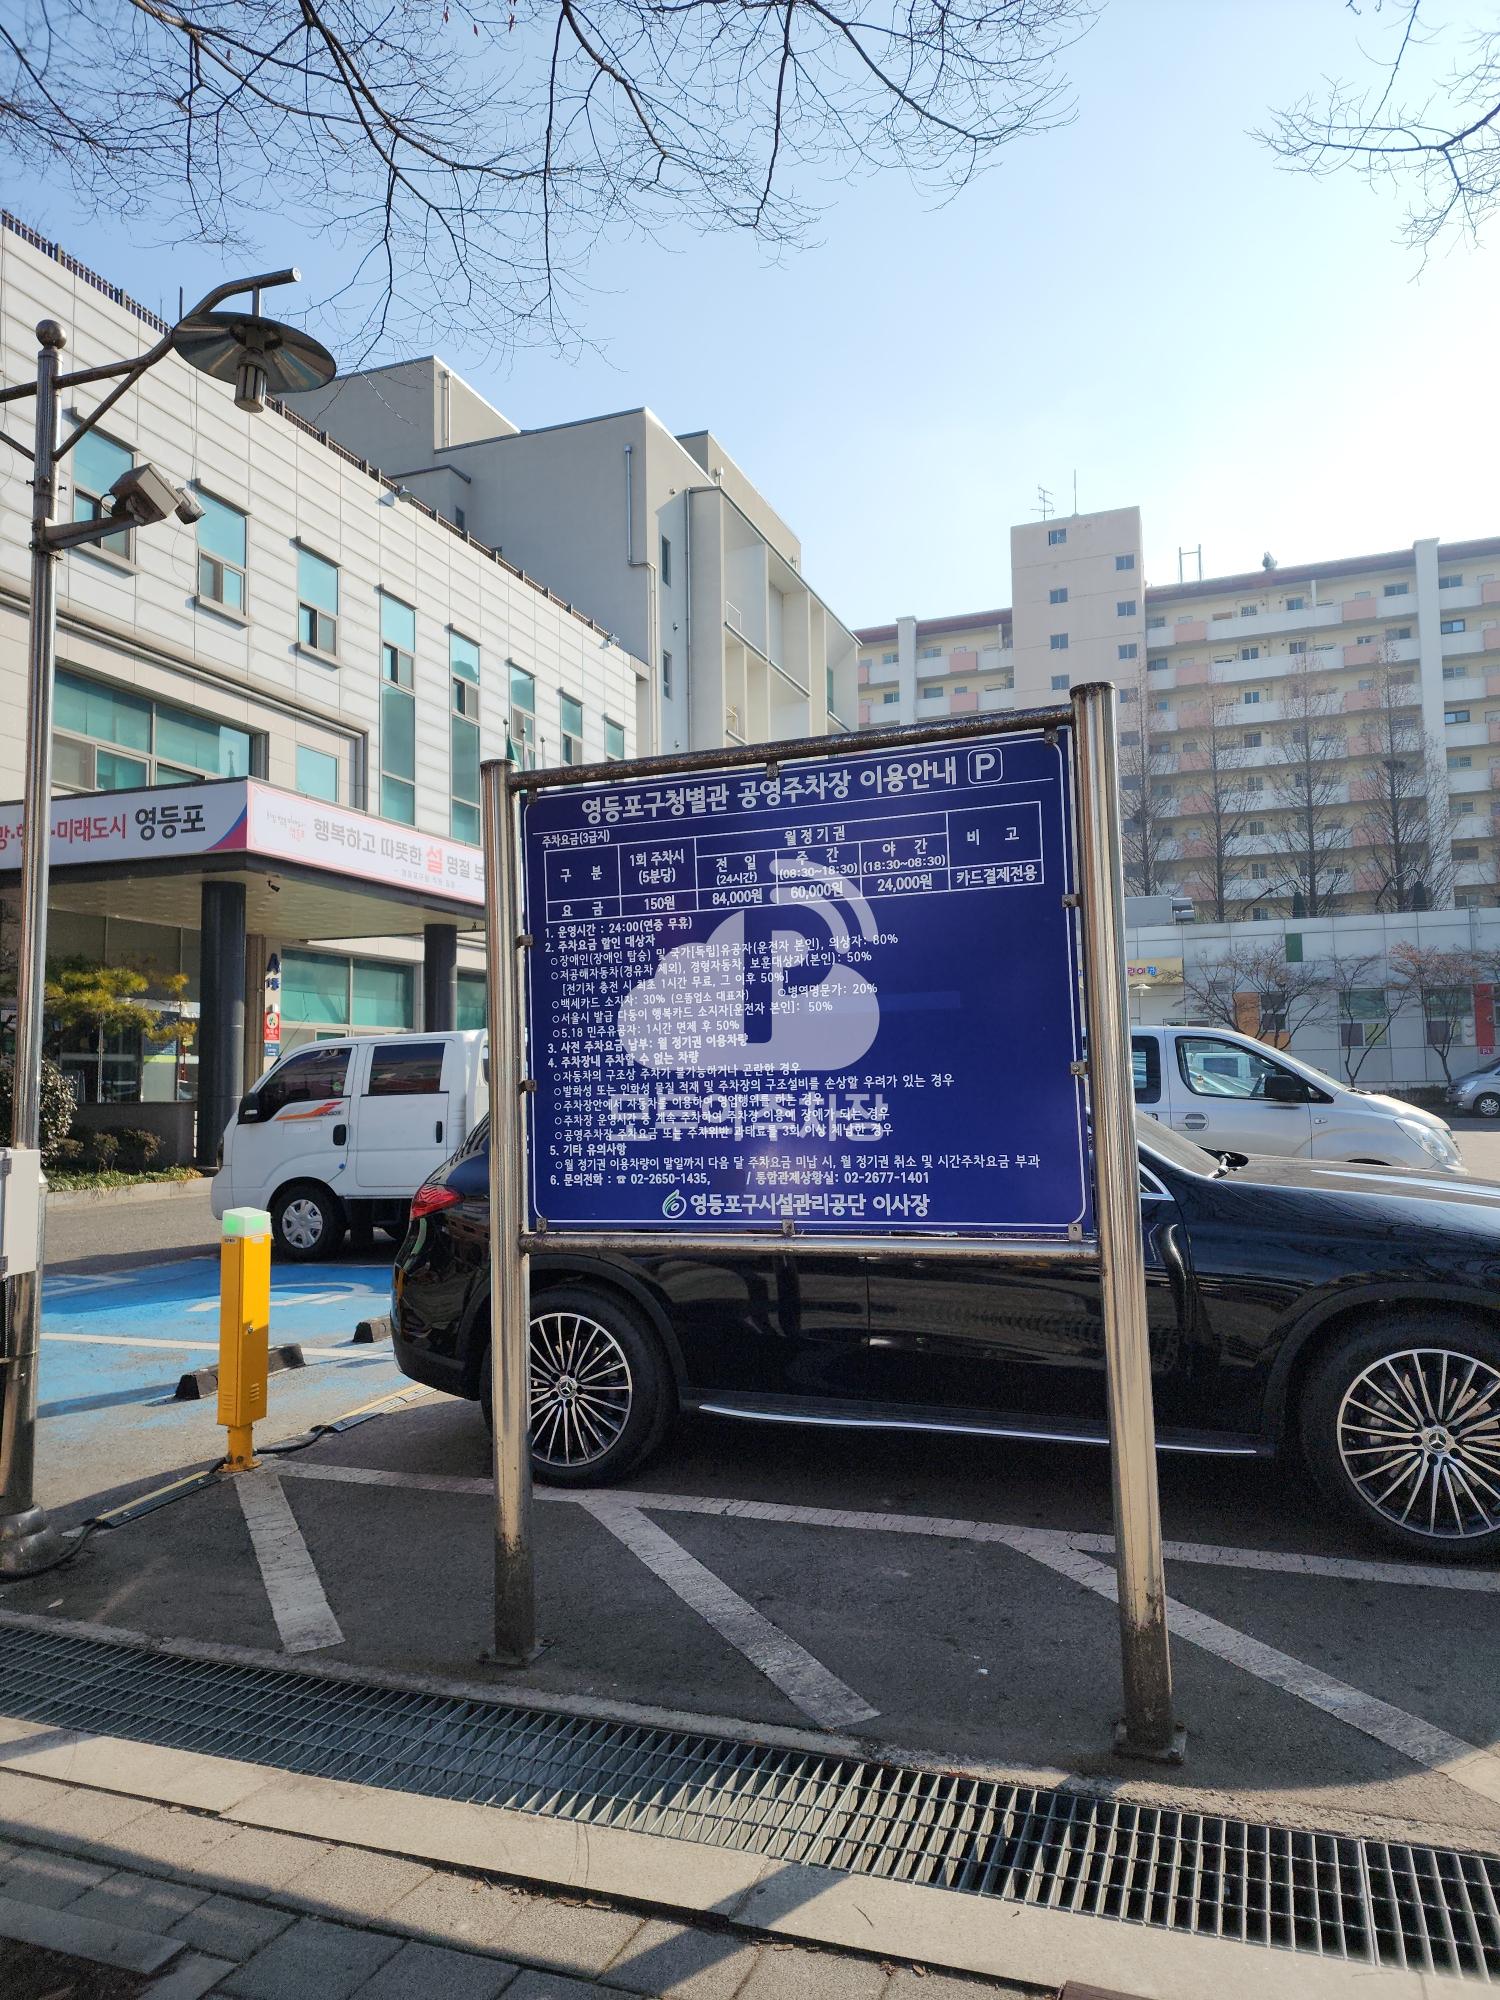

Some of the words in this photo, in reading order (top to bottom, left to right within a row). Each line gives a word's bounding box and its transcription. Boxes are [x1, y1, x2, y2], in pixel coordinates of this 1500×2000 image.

[582, 784, 729, 824] 영등포구청별관
[738, 769, 851, 807] 공영주차장
[860, 756, 956, 793] 이용안내
[976, 753, 995, 779] P
[135, 805, 205, 841] 영등포
[314, 818, 376, 854] 행복하고
[381, 838, 421, 865] 따뜻한
[426, 845, 443, 875] 설
[447, 855, 471, 878] 명절
[542, 830, 610, 848] 주차요금(3급지)
[629, 855, 646, 867] 1회
[651, 849, 684, 864] 주차시
[863, 855, 945, 873] (18:30~08:30)
[639, 868, 675, 884] (5분당)
[716, 872, 757, 884] (24시간)
[780, 862, 857, 881] (08:30~18:30)
[956, 865, 1037, 885] 카드결제전용
[791, 882, 843, 899] 60,000원
[877, 874, 932, 892] 24,000원
[644, 896, 675, 911] 150원
[712, 888, 763, 905] 84,000원
[558, 925, 596, 939] 운영시간
[668, 917, 692, 930] 무휴)
[558, 939, 597, 952] 주차요금
[602, 937, 620, 948] 할인
[625, 934, 655, 947] 대상자
[627, 949, 651, 962] 탑승)
[656, 949, 665, 960] 및
[873, 934, 898, 945] 80%
[847, 952, 872, 962] 50%
[599, 980, 618, 993] 충전
[623, 980, 632, 992] 시
[637, 979, 657, 990] 최초
[662, 977, 687, 990] 1시간
[721, 976, 730, 985] 그
[736, 973, 756, 984] 이후
[761, 971, 789, 984] 50%]
[605, 995, 638, 1007] 소지자:
[643, 994, 665, 1005] 30%
[717, 989, 749, 1002] 대표자)
[853, 984, 877, 995] 20%
[594, 1010, 613, 1022] 발급
[618, 1008, 647, 1021] 다둥이
[652, 1006, 693, 1019] 행복카드
[809, 1001, 833, 1011] 50%
[588, 1024, 640, 1037] 민주유공자:
[647, 1022, 672, 1034] 1시간
[677, 1021, 696, 1033] 면제
[702, 1020, 711, 1031] 후
[716, 1019, 739, 1030] 50%
[561, 1041, 580, 1054] 사전
[584, 1039, 623, 1052] 주차요금
[629, 1038, 653, 1051] 납부:
[658, 1037, 667, 1049] 월
[672, 1035, 701, 1048] 정기권
[706, 1033, 748, 1046] 이용차량
[561, 1055, 600, 1069] 주차장내
[605, 1053, 635, 1065] 주차할
[639, 1054, 649, 1065] 수
[654, 1052, 673, 1065] 없는
[679, 1050, 699, 1063] 차량
[606, 1068, 635, 1080] 구조상
[640, 1067, 670, 1079] 주차가
[675, 1064, 737, 1078] 불가능하거나
[743, 1062, 774, 1074] 곤란한
[780, 1062, 800, 1074] 경우
[597, 1084, 616, 1095] 또는
[620, 1083, 649, 1095] 인화성
[655, 1082, 674, 1094] 물질
[680, 1081, 699, 1093] 적재
[704, 1081, 713, 1092] 및
[718, 1079, 761, 1092] 주차장의
[766, 1077, 819, 1091] 구조설비를
[824, 1076, 858, 1090] 손상할
[864, 1074, 898, 1088] 우려가
[903, 1074, 926, 1088] 있는
[931, 1073, 954, 1087] 경우
[627, 1096, 667, 1110] 자동차를
[673, 1096, 712, 1109] 이용하여
[717, 1094, 770, 1108] 영업행위를
[776, 1093, 796, 1106] 하는
[802, 1092, 823, 1106] 경우
[598, 1112, 636, 1126] 운영시간
[641, 1112, 651, 1124] 중
[656, 1112, 676, 1124] 계속
[681, 1109, 721, 1123] 주차하여
[728, 1108, 758, 1123] 주차장
[764, 1109, 795, 1121] 이용에
[801, 1108, 834, 1121] 장애가
[840, 1108, 863, 1120] 되는
[868, 1107, 890, 1120] 경우
[617, 1127, 657, 1140] 주차요금
[663, 1127, 683, 1139] 또는
[688, 1125, 729, 1138] 주차위반
[735, 1123, 778, 1138] 과태료를
[783, 1124, 800, 1137] 3회
[805, 1123, 826, 1137] 이상
[832, 1122, 864, 1136] 체납한
[871, 1122, 893, 1136] 경우
[564, 1144, 582, 1156] 기타
[587, 1143, 626, 1155] 유의사항
[578, 1158, 605, 1171] 정기권
[610, 1157, 659, 1170] 이용차량이
[664, 1156, 704, 1170] 말일까지
[709, 1156, 729, 1169] 다음
[734, 1156, 743, 1168] 달
[748, 1156, 791, 1168] 주차요금
[796, 1156, 817, 1168] 미납
[822, 1156, 836, 1168] 시,
[840, 1155, 851, 1168] 월
[856, 1154, 889, 1168] 정기권
[894, 1154, 916, 1168] 취소
[922, 1155, 932, 1168] 및
[938, 1154, 1009, 1168] 시간주차요금
[1015, 1154, 1040, 1168] 부과
[564, 1174, 603, 1186] 문의전화
[756, 1171, 838, 1185] 통합관제상황실:
[844, 1171, 929, 1184] 02-2677-1401
[690, 1193, 866, 1216] 영등포구시설관리공단
[873, 1193, 930, 1217] 이사장
